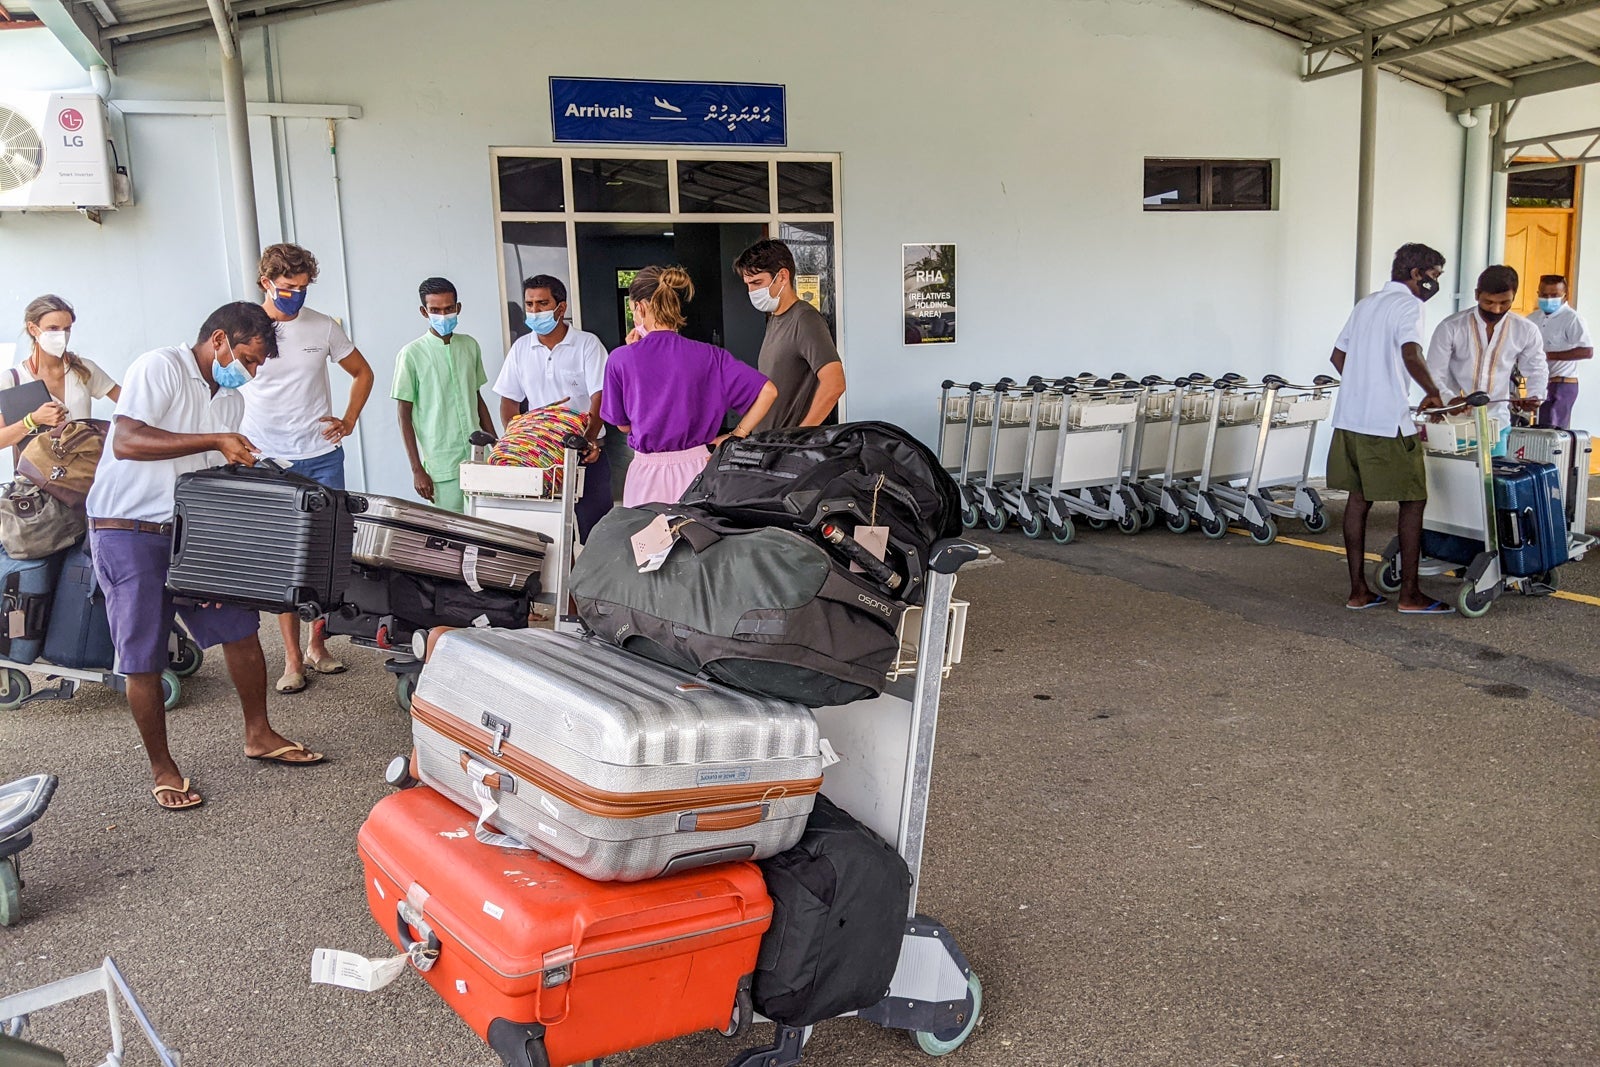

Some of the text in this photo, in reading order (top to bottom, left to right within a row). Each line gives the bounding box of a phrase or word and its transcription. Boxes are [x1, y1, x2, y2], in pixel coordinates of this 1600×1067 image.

[565, 103, 633, 119] Arrivals
[63, 135, 84, 147] LG
[916, 270, 944, 283] RHA
[909, 292, 951, 301] (RELATIVES
[915, 301, 948, 309] HOLDING
[918, 310, 942, 318] AREA)
[858, 593, 893, 617] osprey
